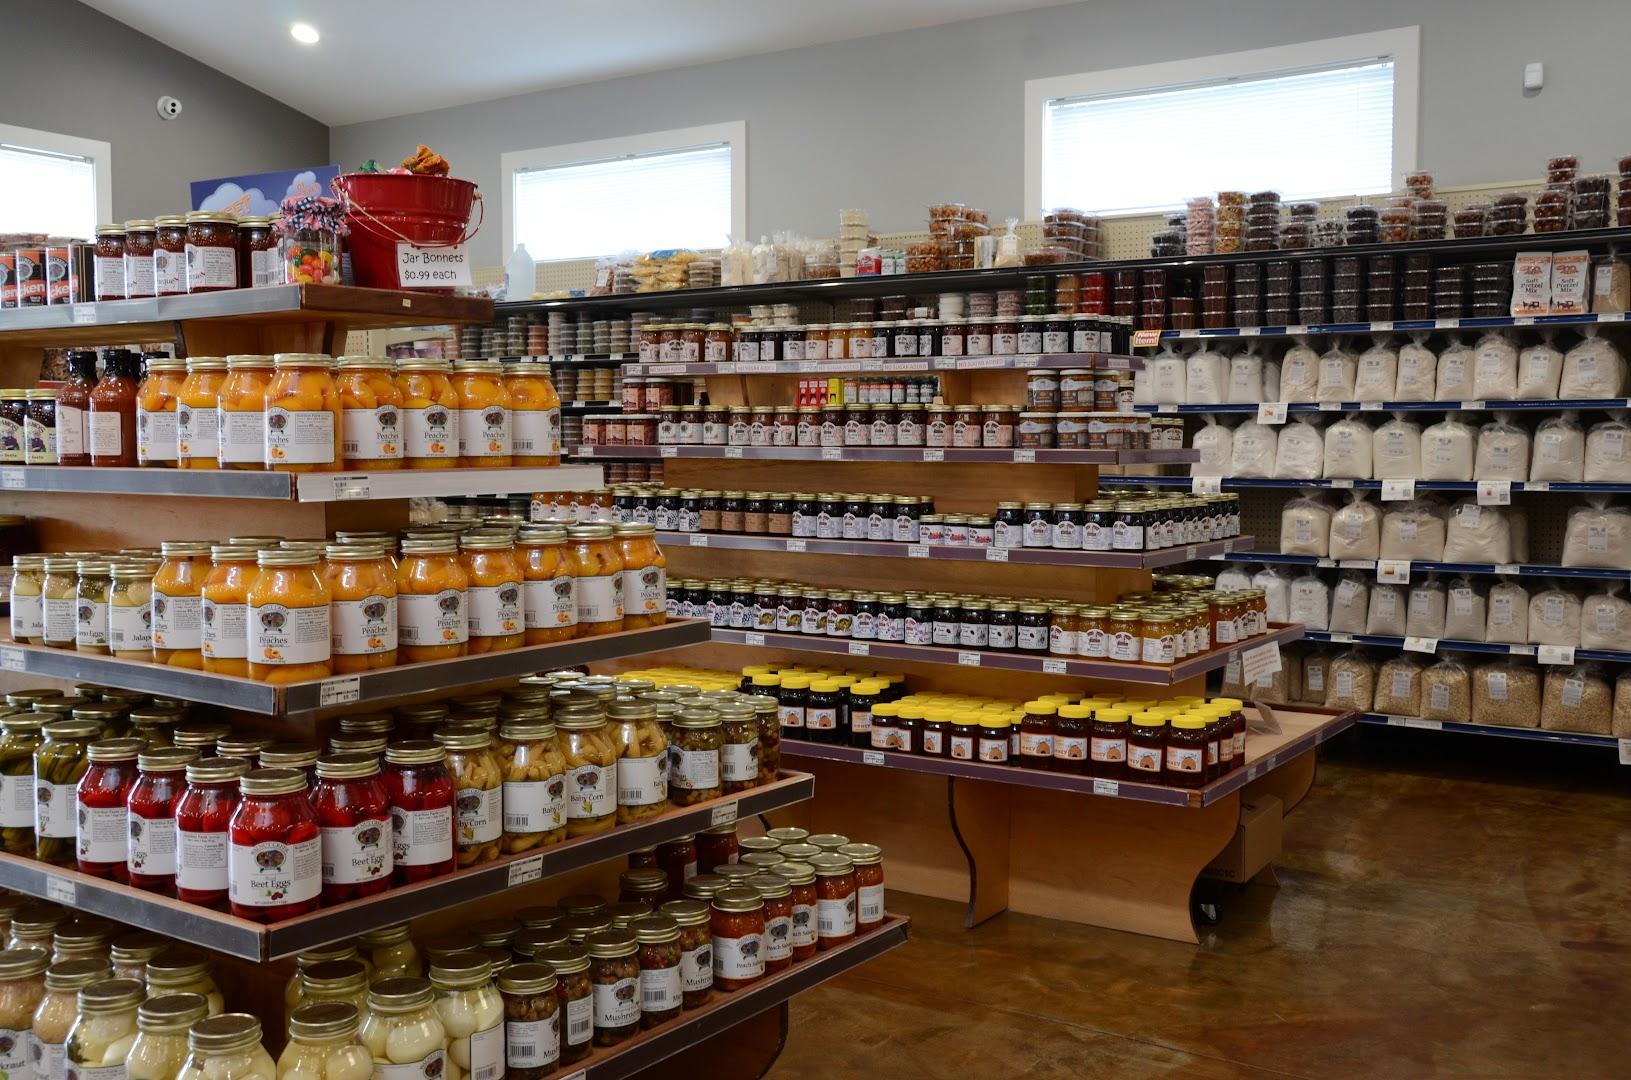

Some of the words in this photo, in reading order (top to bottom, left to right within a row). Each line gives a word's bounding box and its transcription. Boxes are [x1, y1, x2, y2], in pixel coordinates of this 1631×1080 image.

[402, 252, 420, 264] Jar
[423, 252, 464, 263] Bonnets
[404, 270, 430, 280] $0.99
[432, 270, 457, 280] each
[376, 432, 399, 440] Peaches
[424, 431, 449, 439] Peaches
[482, 431, 505, 439] Peaches
[362, 625, 388, 635] Peaches
[132, 634, 152, 642] Jalap
[259, 636, 288, 645] Peaches
[570, 794, 588, 803] Baby
[588, 793, 604, 801] Corn
[542, 806, 557, 815] Baby
[469, 818, 487, 826] Corn
[393, 841, 411, 850] Eggs
[351, 857, 369, 866] Beet
[370, 854, 385, 865] Eggs
[250, 879, 268, 888] Beet
[270, 879, 291, 889] Eggs
[1, 1060, 25, 1070] kraut
